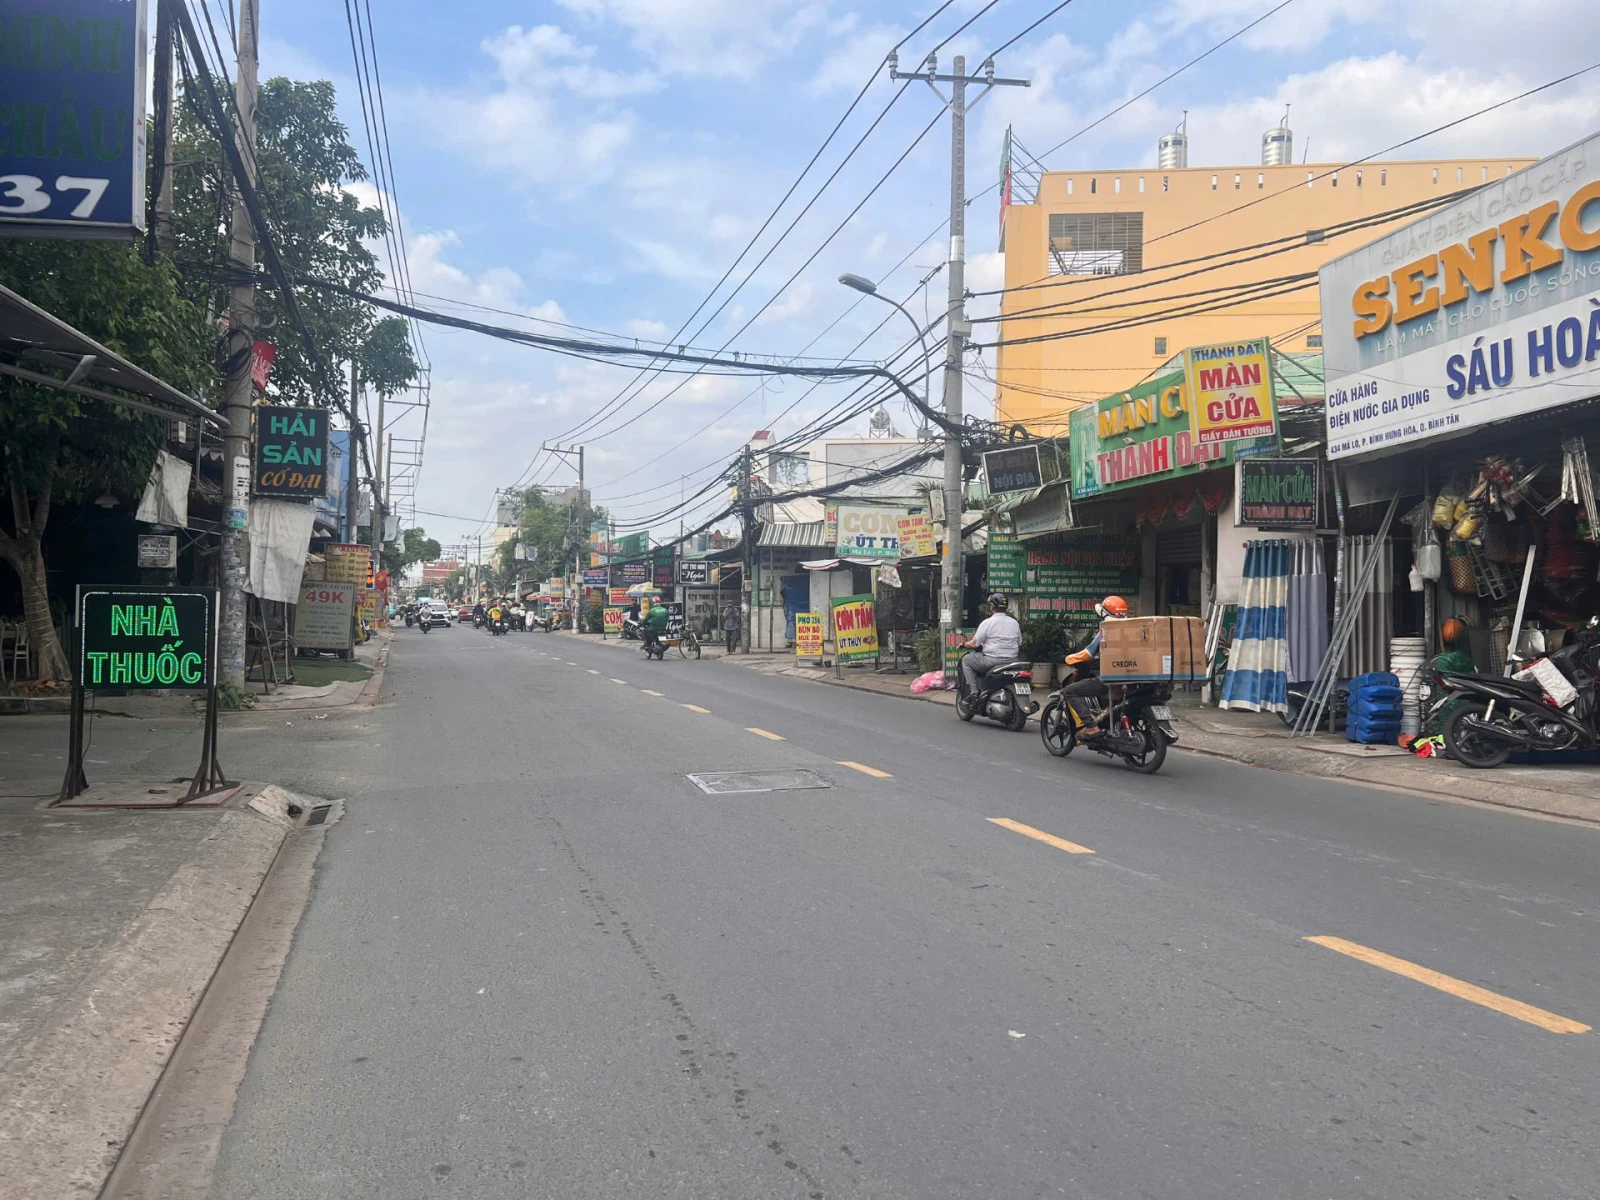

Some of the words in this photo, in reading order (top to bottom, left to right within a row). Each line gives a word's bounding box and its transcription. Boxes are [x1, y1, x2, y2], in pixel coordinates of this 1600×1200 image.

[1381, 228, 1430, 265] QUẠT
[1433, 207, 1481, 244] ĐIỆN
[1486, 186, 1532, 218] CAO
[1537, 156, 1587, 194] CẤP
[1448, 305, 1483, 326] CHO
[1490, 283, 1541, 312] CUỘC
[1547, 261, 1600, 292] SỐNG
[1200, 361, 1262, 392] MÀN
[1446, 335, 1514, 400] SÁU
[1207, 392, 1262, 424] CỬA
[1329, 388, 1348, 408] CỬA
[1350, 380, 1378, 402] HÀNG
[1330, 411, 1351, 429] ĐIỆN
[1353, 402, 1379, 423] NƯỚC
[1382, 398, 1399, 414] GIA
[1401, 388, 1430, 410] DỤNG
[271, 412, 316, 437] HẢI
[1098, 393, 1158, 440] MÀN
[1330, 445, 1341, 454] 434
[1361, 437, 1369, 446] P.
[1369, 432, 1384, 445] BÌNH
[1385, 428, 1402, 441] HƯNG
[1428, 417, 1445, 430] BÌNH
[1446, 413, 1460, 426] TÂN
[263, 441, 321, 466] SẢN
[1097, 435, 1174, 485] THÀNH
[289, 472, 322, 492] ĐẠI
[994, 473, 1013, 489] NỘI
[1015, 471, 1036, 486] ĐỊA
[1245, 466, 1281, 503] MÀN
[1282, 465, 1313, 503] CỬA
[856, 534, 877, 548] ÚT
[1027, 549, 1058, 566] HÀNG
[1060, 548, 1081, 568] NỘI
[305, 590, 345, 604] 49K
[111, 596, 180, 636] NHÀ
[798, 624, 811, 633] BÚN
[835, 607, 855, 631] CƠM
[854, 600, 874, 629] TẤM
[87, 640, 202, 684] THUỐC
[1111, 660, 1138, 668] CREORA
